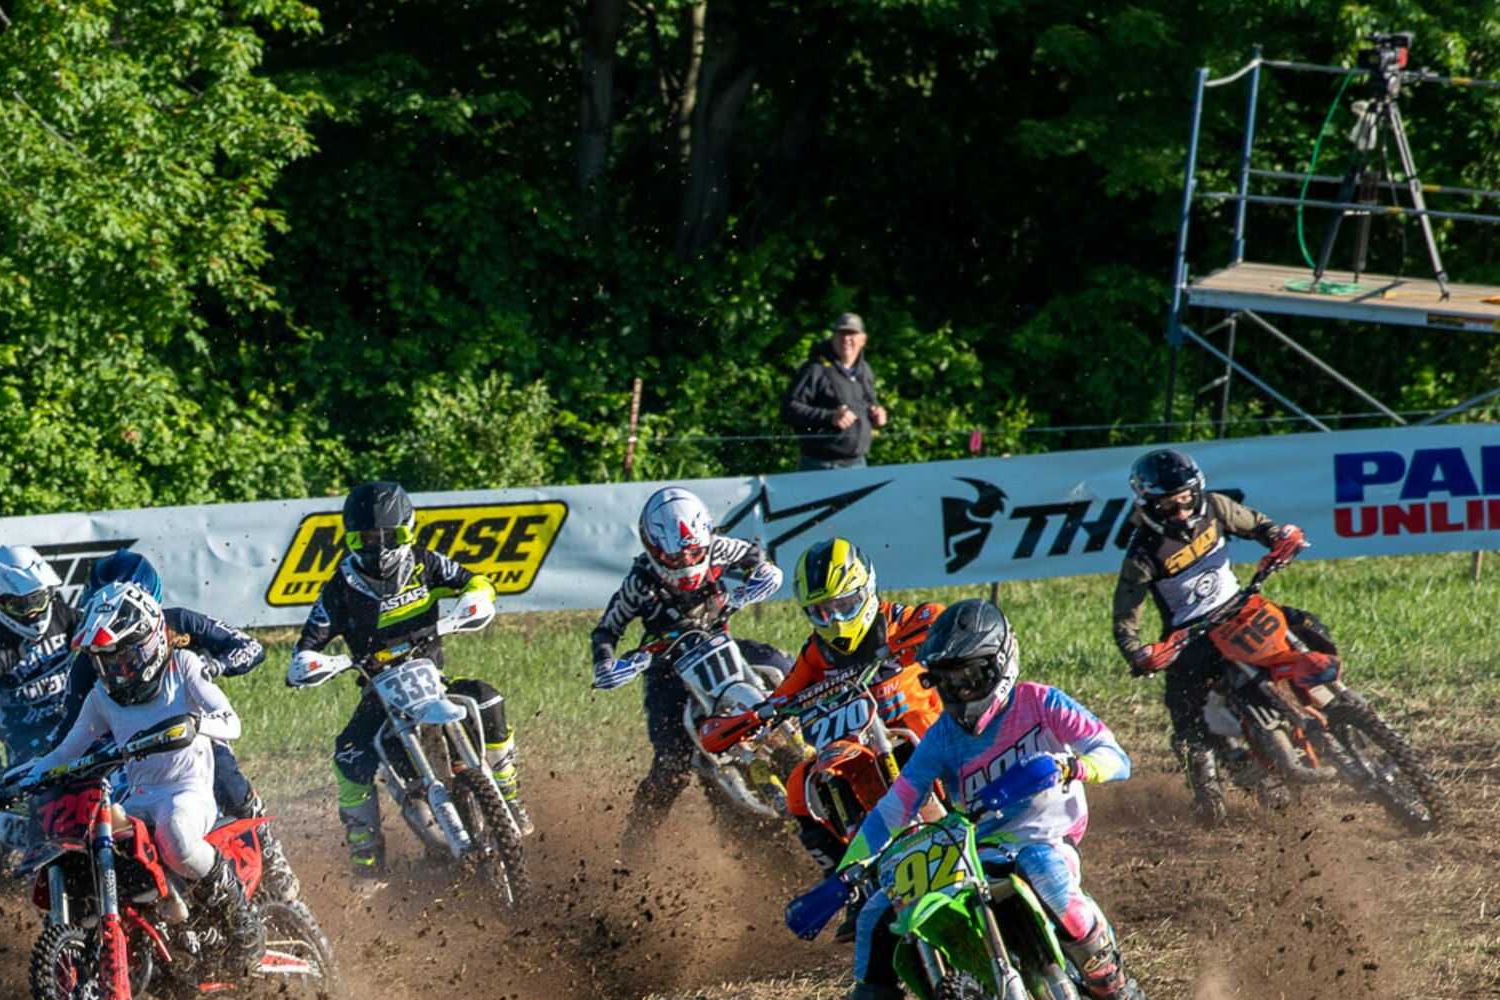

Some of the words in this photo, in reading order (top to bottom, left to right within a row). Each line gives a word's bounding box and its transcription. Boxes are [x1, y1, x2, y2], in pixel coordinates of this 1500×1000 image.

[294, 515, 548, 574] MOSE
[1333, 499, 1500, 538] UNLI
[384, 669, 438, 708] 333
[811, 698, 868, 751] 270
[894, 844, 965, 902] 92
